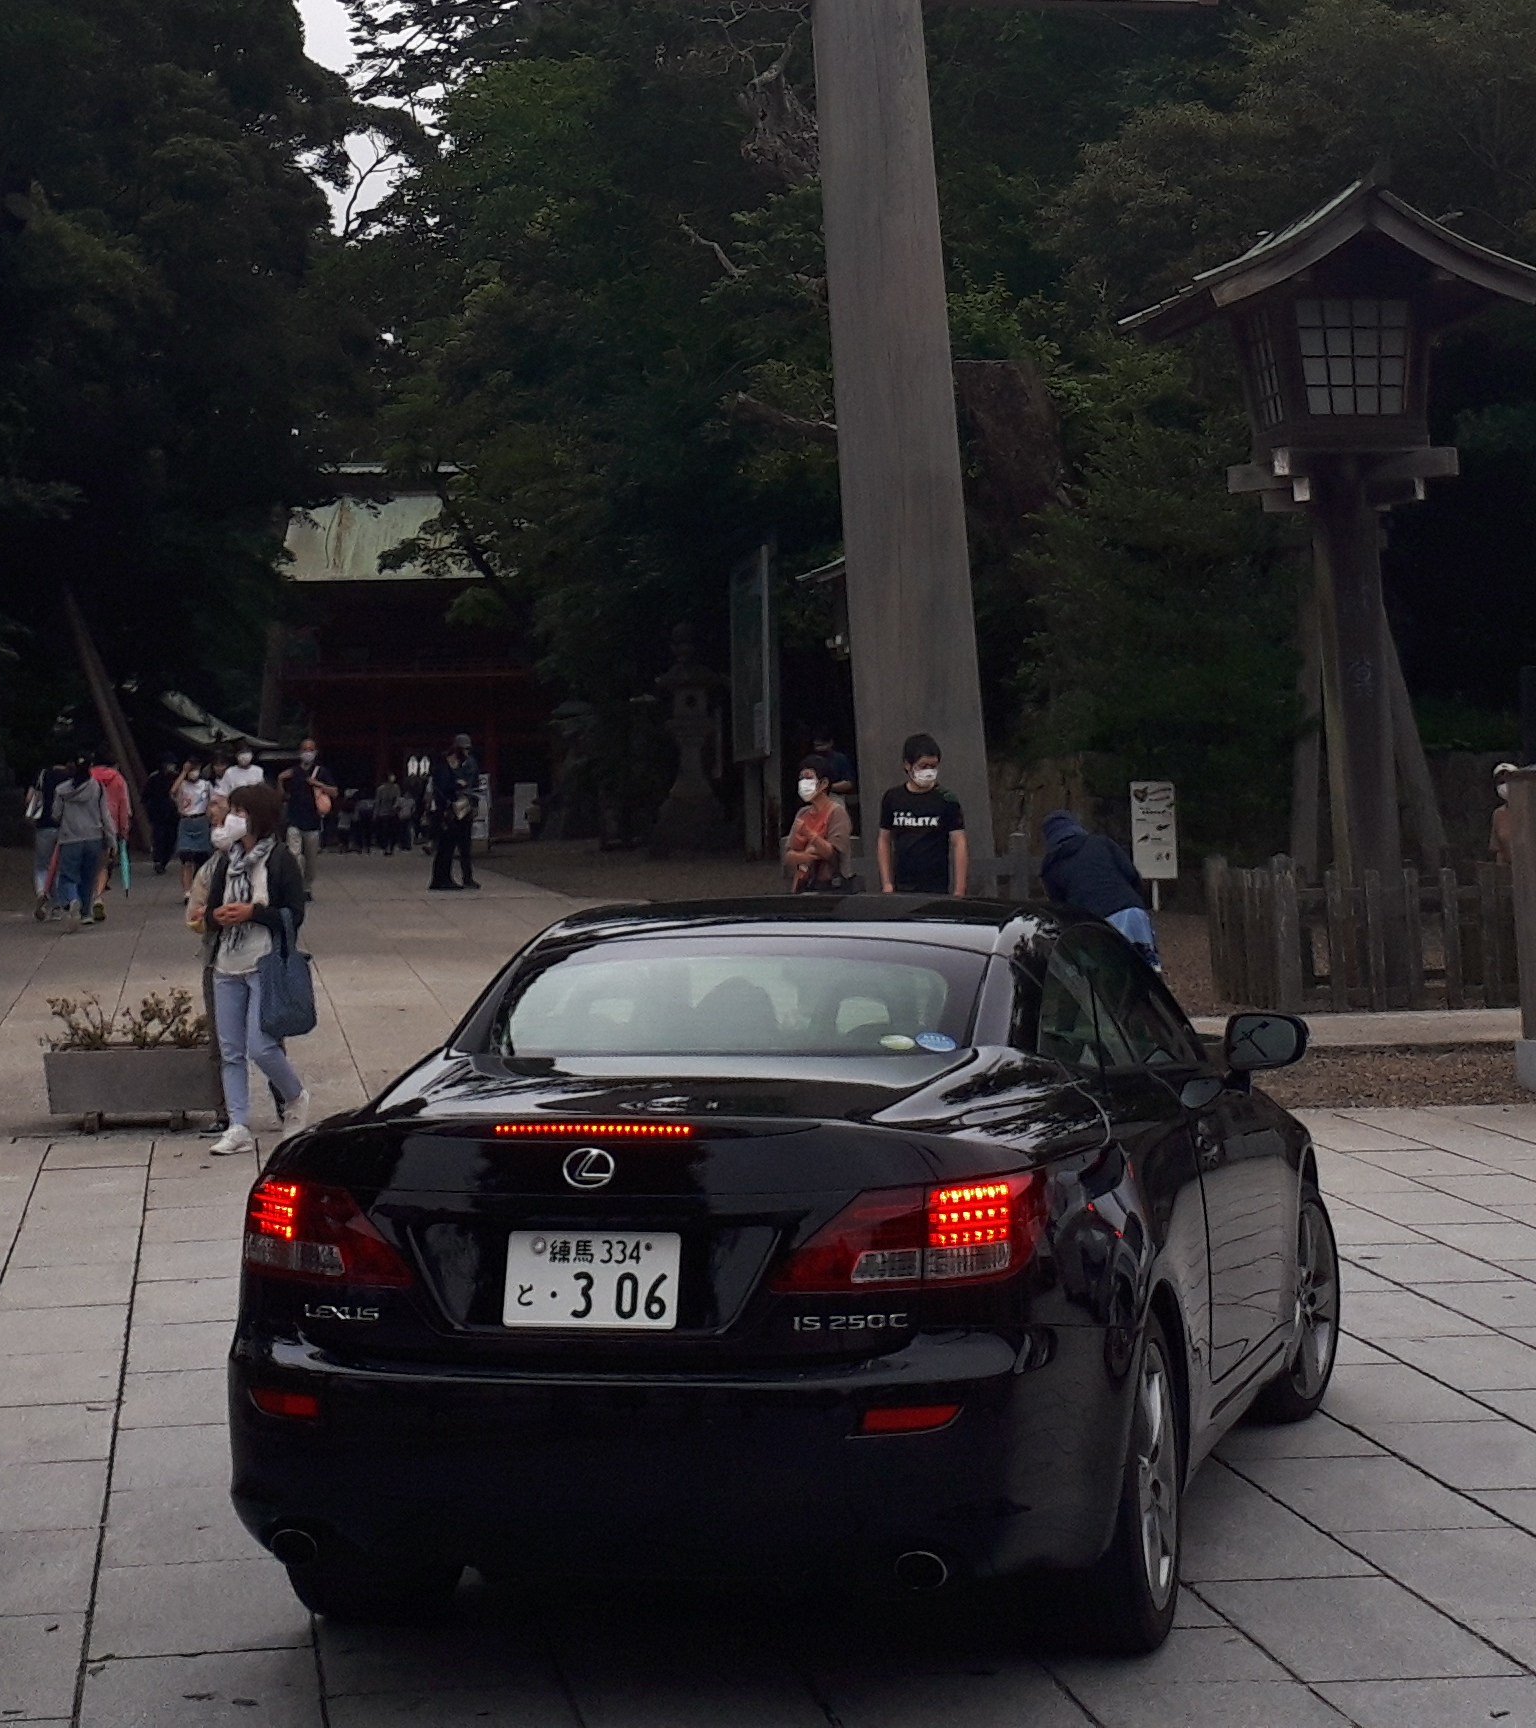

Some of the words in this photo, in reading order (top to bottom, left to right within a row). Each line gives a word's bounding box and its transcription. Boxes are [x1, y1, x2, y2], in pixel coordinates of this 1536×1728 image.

[549, 1239, 594, 1264] 練馬
[599, 1239, 642, 1264] 334
[517, 1284, 534, 1306] と
[304, 1303, 381, 1321] LEXUS
[792, 1315, 821, 1331] IS
[828, 1313, 909, 1331] 250C
